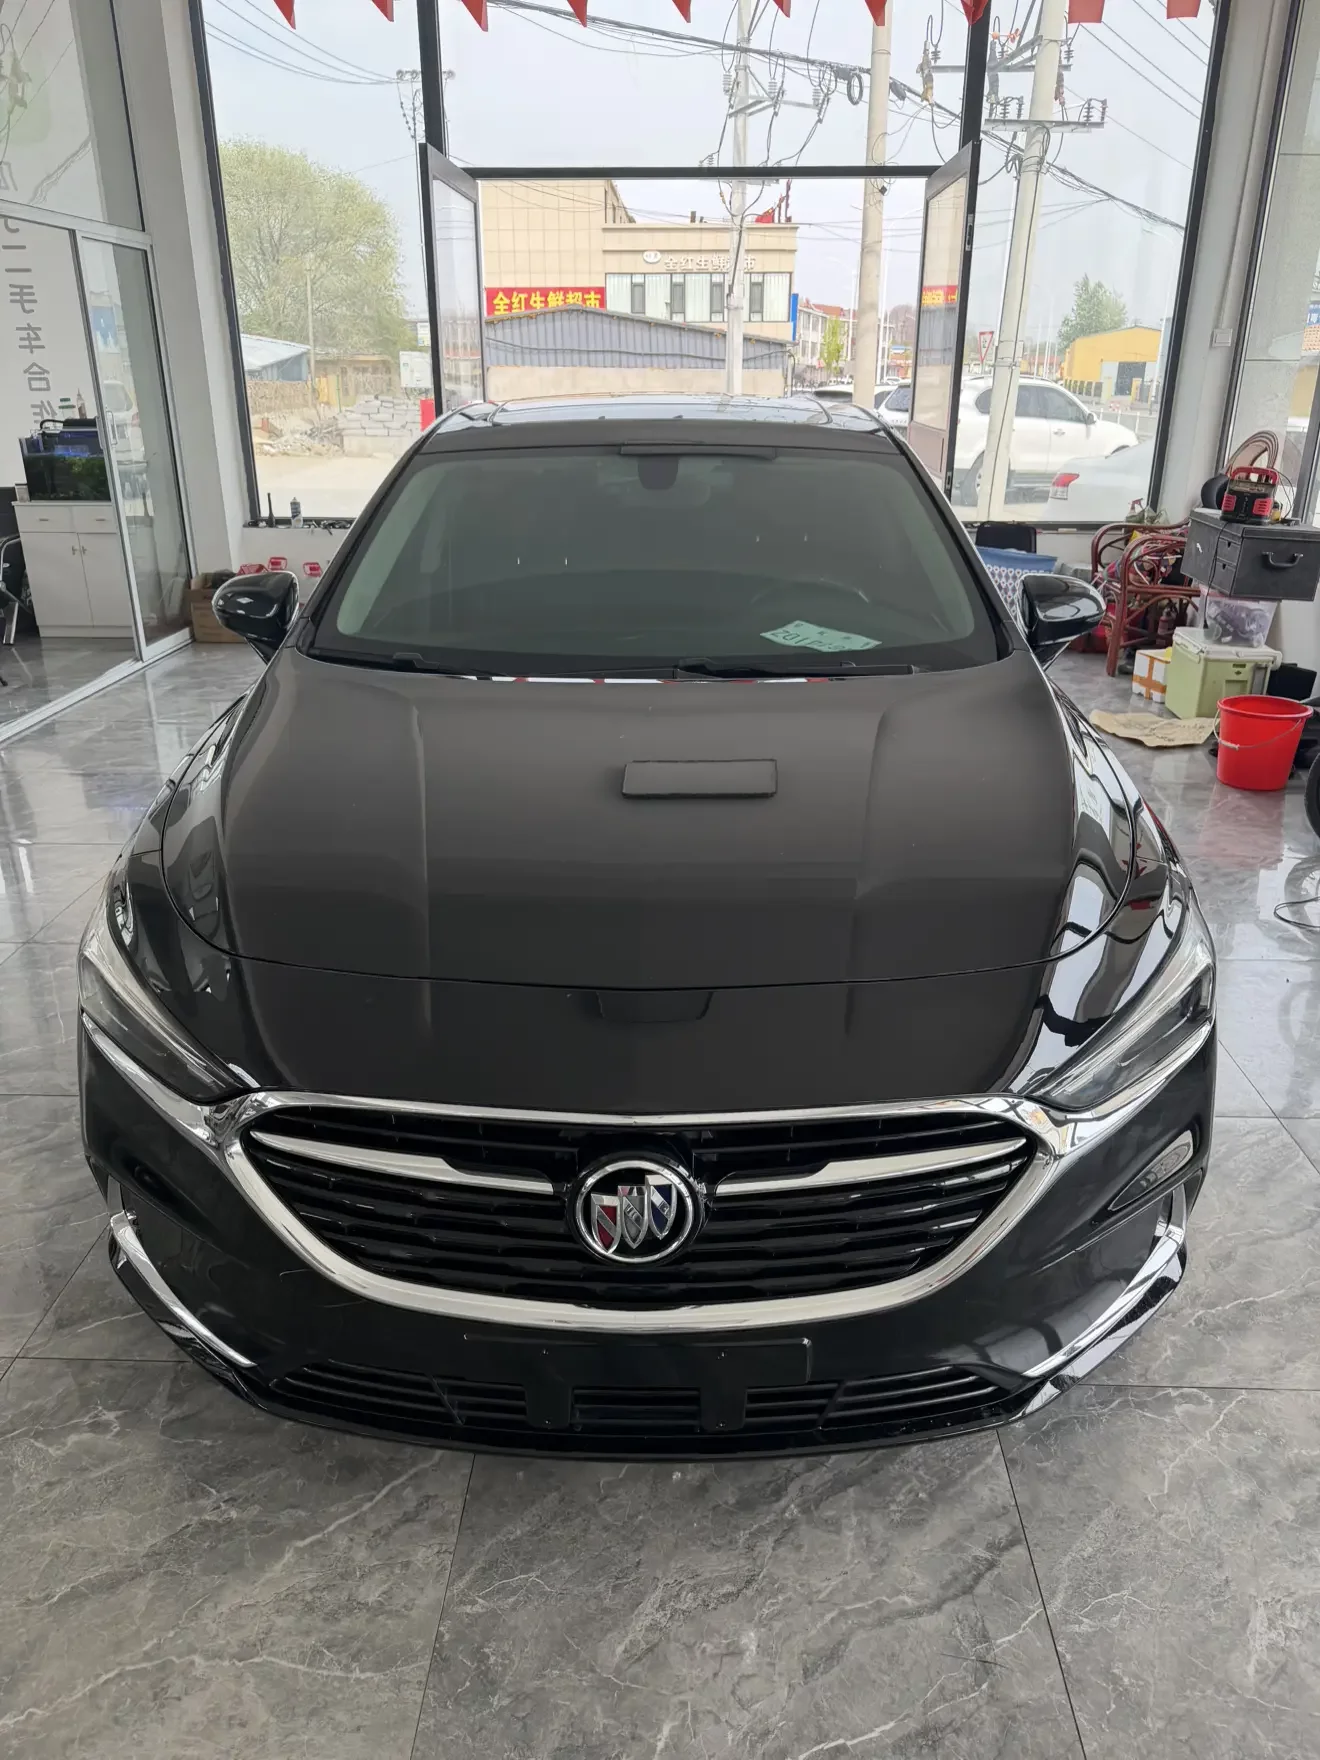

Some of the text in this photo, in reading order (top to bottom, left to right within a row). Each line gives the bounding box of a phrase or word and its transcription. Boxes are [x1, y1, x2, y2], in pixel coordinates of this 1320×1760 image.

[664, 253, 756, 271] 全红生鲜市
[493, 290, 601, 315] 全红生鲜超市
